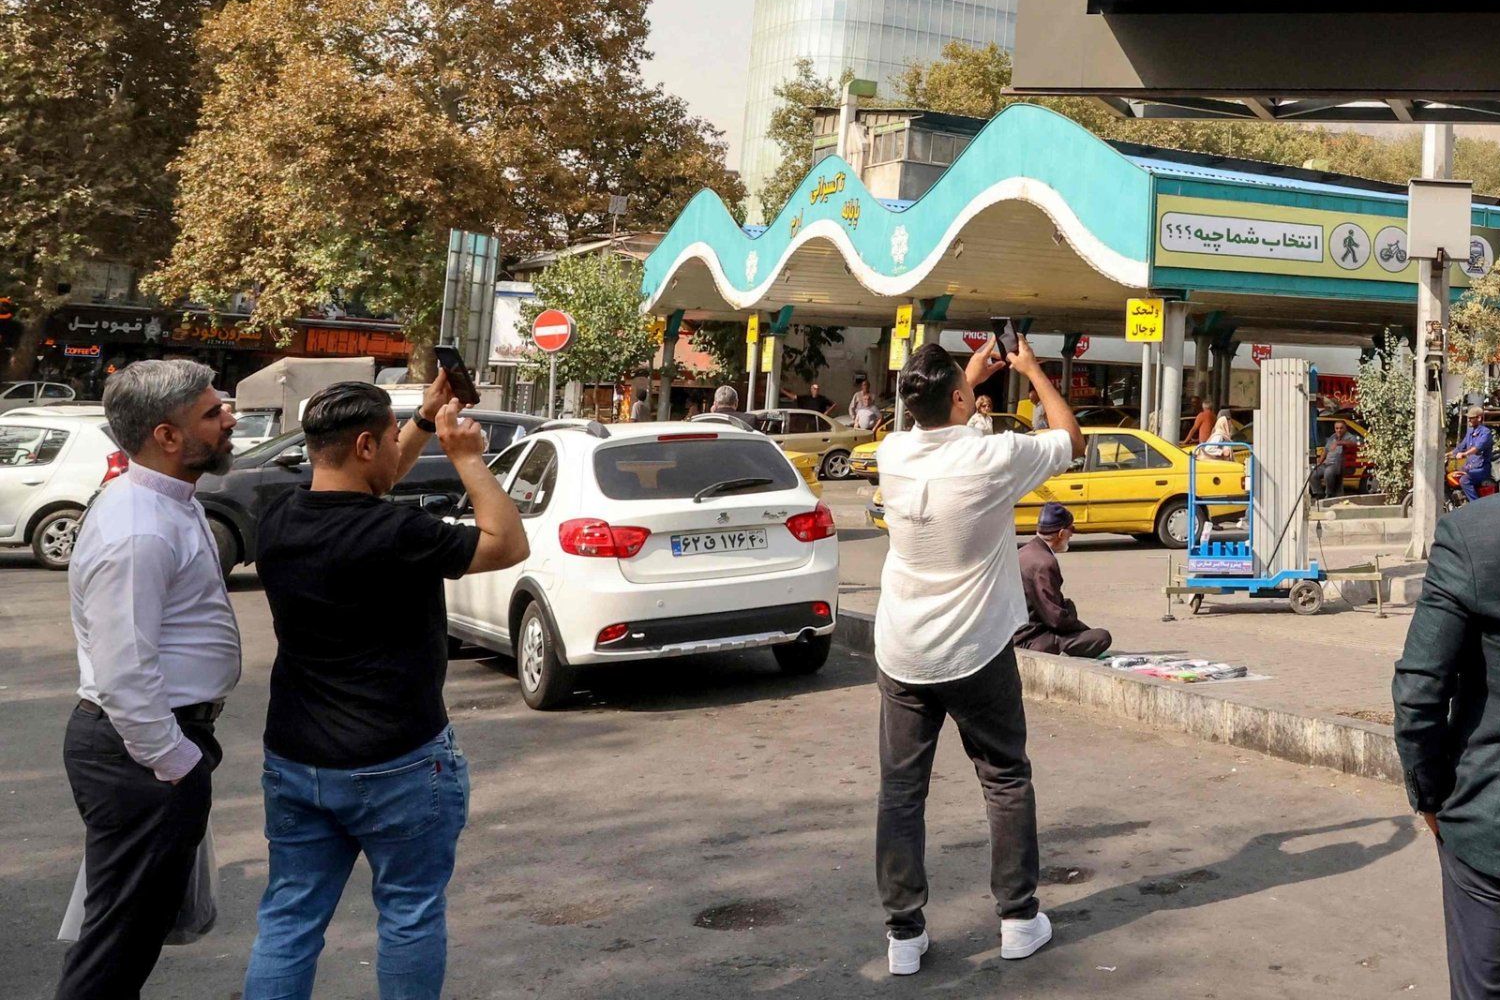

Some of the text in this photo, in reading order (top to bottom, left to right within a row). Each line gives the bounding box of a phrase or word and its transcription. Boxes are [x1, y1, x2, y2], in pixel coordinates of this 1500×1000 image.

[810, 171, 846, 205] تاکسیرانی
[1226, 227, 1259, 245] شما
[1262, 233, 1318, 251] انتخاب
[1132, 305, 1159, 318] ولنجک
[68, 316, 142, 335] قهوه پل
[65, 347, 90, 355] COFFEE
[682, 536, 700, 552] ۶۲
[704, 535, 716, 550] ق
[720, 533, 746, 549] ۱۷۶
